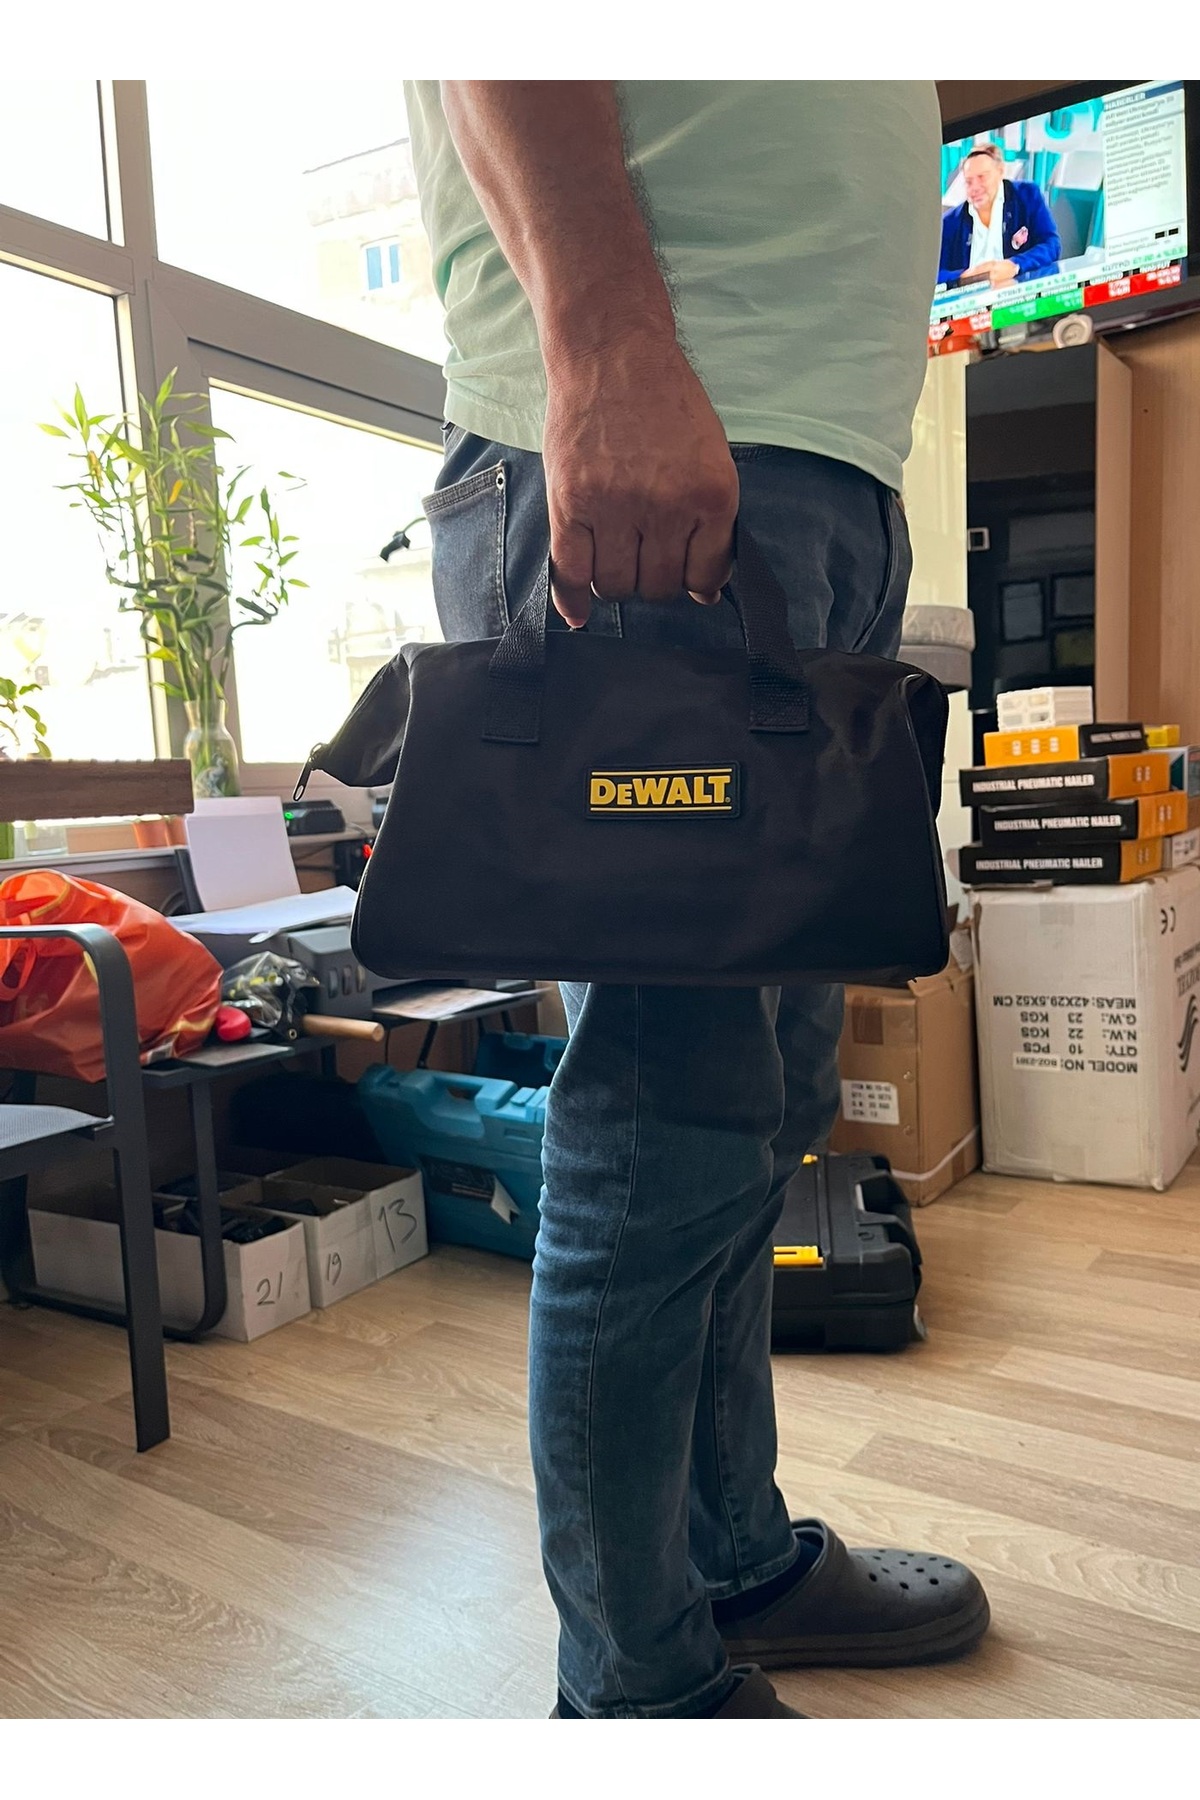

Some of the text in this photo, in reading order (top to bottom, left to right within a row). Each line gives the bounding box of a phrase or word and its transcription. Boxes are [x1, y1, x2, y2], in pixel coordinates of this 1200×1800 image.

[590, 775, 731, 805] DEWALT
[972, 774, 1094, 793] INDUSTRIAL PNEUMATIC NAILER
[994, 815, 1122, 831] INDUSTRIAL PNEUMATIC NAILER
[975, 857, 1103, 871] INDUSTRIAL PNEUMATIC NAILER
[993, 995, 1013, 1007] CM
[1092, 996, 1136, 1009] MEAS:
[1020, 1011, 1049, 1023] KGS
[1067, 1012, 1083, 1023] 23
[1021, 1027, 1050, 1038] KGS
[1068, 1027, 1084, 1039] 22
[1023, 1042, 1138, 1057] QTY: 10 PCS
[1060, 1058, 1085, 1071] NO:
[1088, 1059, 1138, 1074] MODEL
[378, 1198, 418, 1254] 13
[327, 1252, 342, 1287] 19
[257, 1271, 283, 1306] 21
